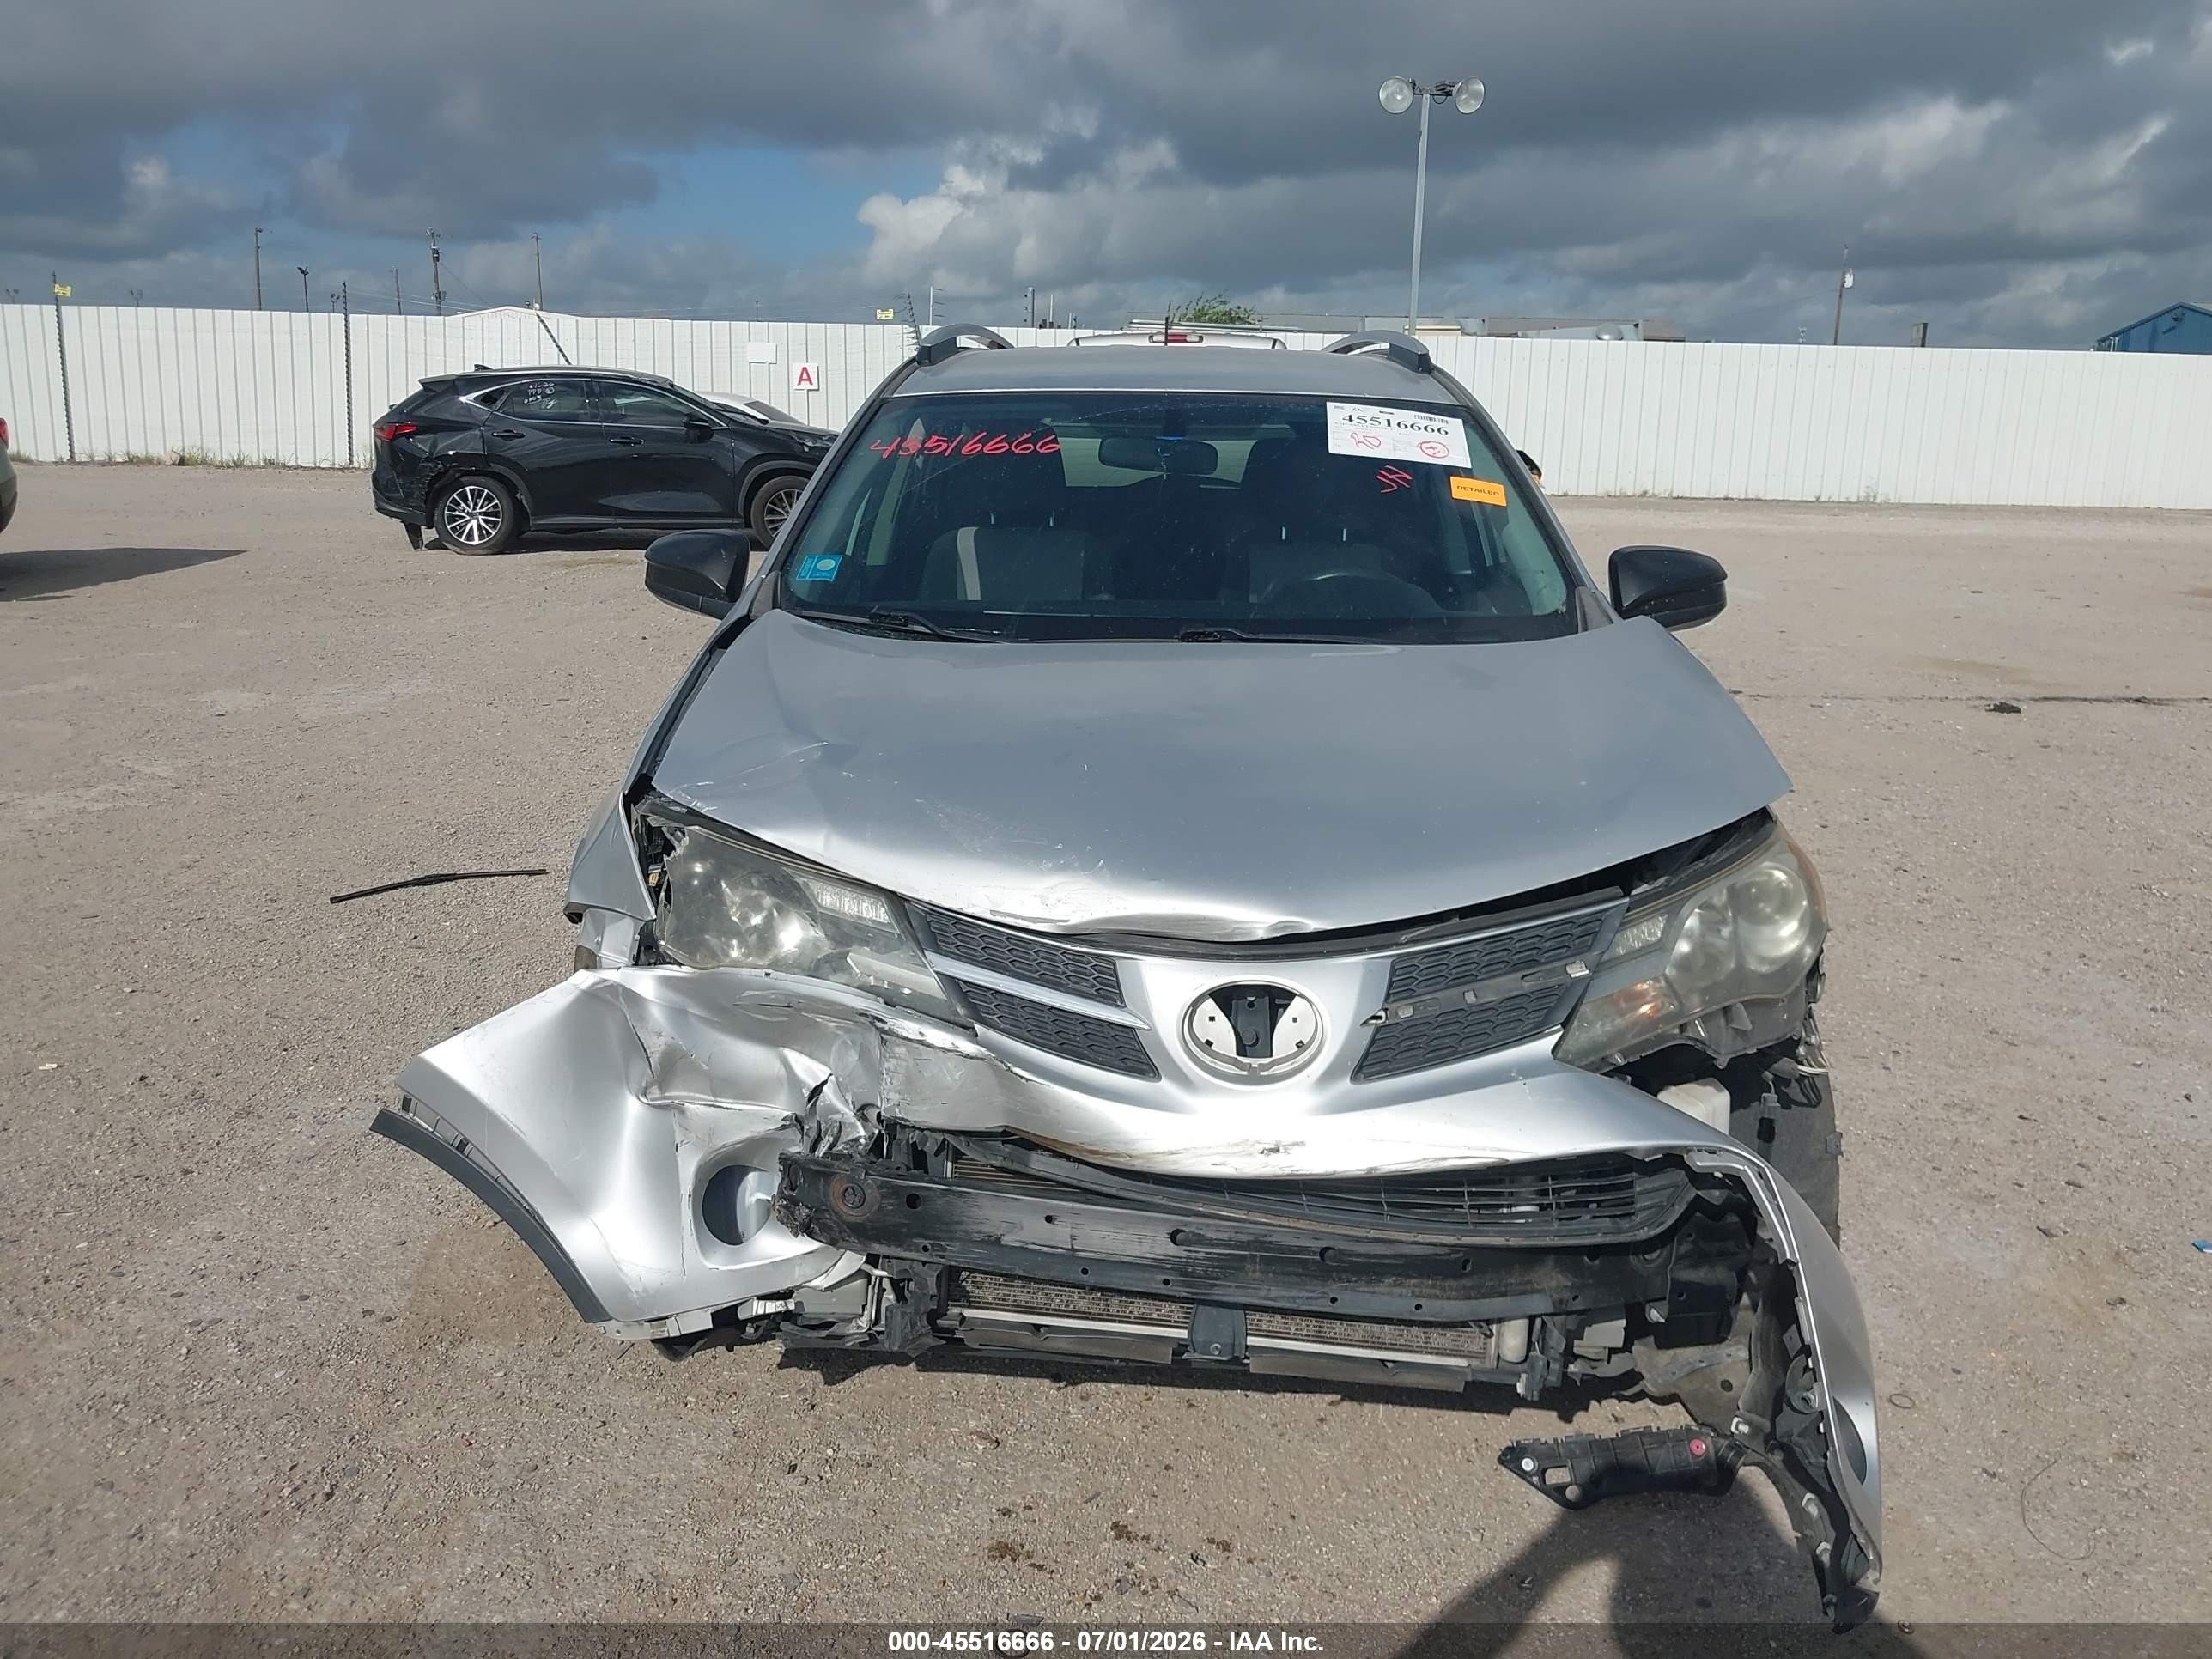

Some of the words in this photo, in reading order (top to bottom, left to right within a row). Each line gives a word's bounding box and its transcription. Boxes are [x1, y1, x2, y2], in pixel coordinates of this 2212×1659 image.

[797, 366, 814, 386] A
[1342, 414, 1449, 436] 45516666
[870, 431, 1061, 459] 45516666
[1455, 484, 1501, 497] DETAILED
